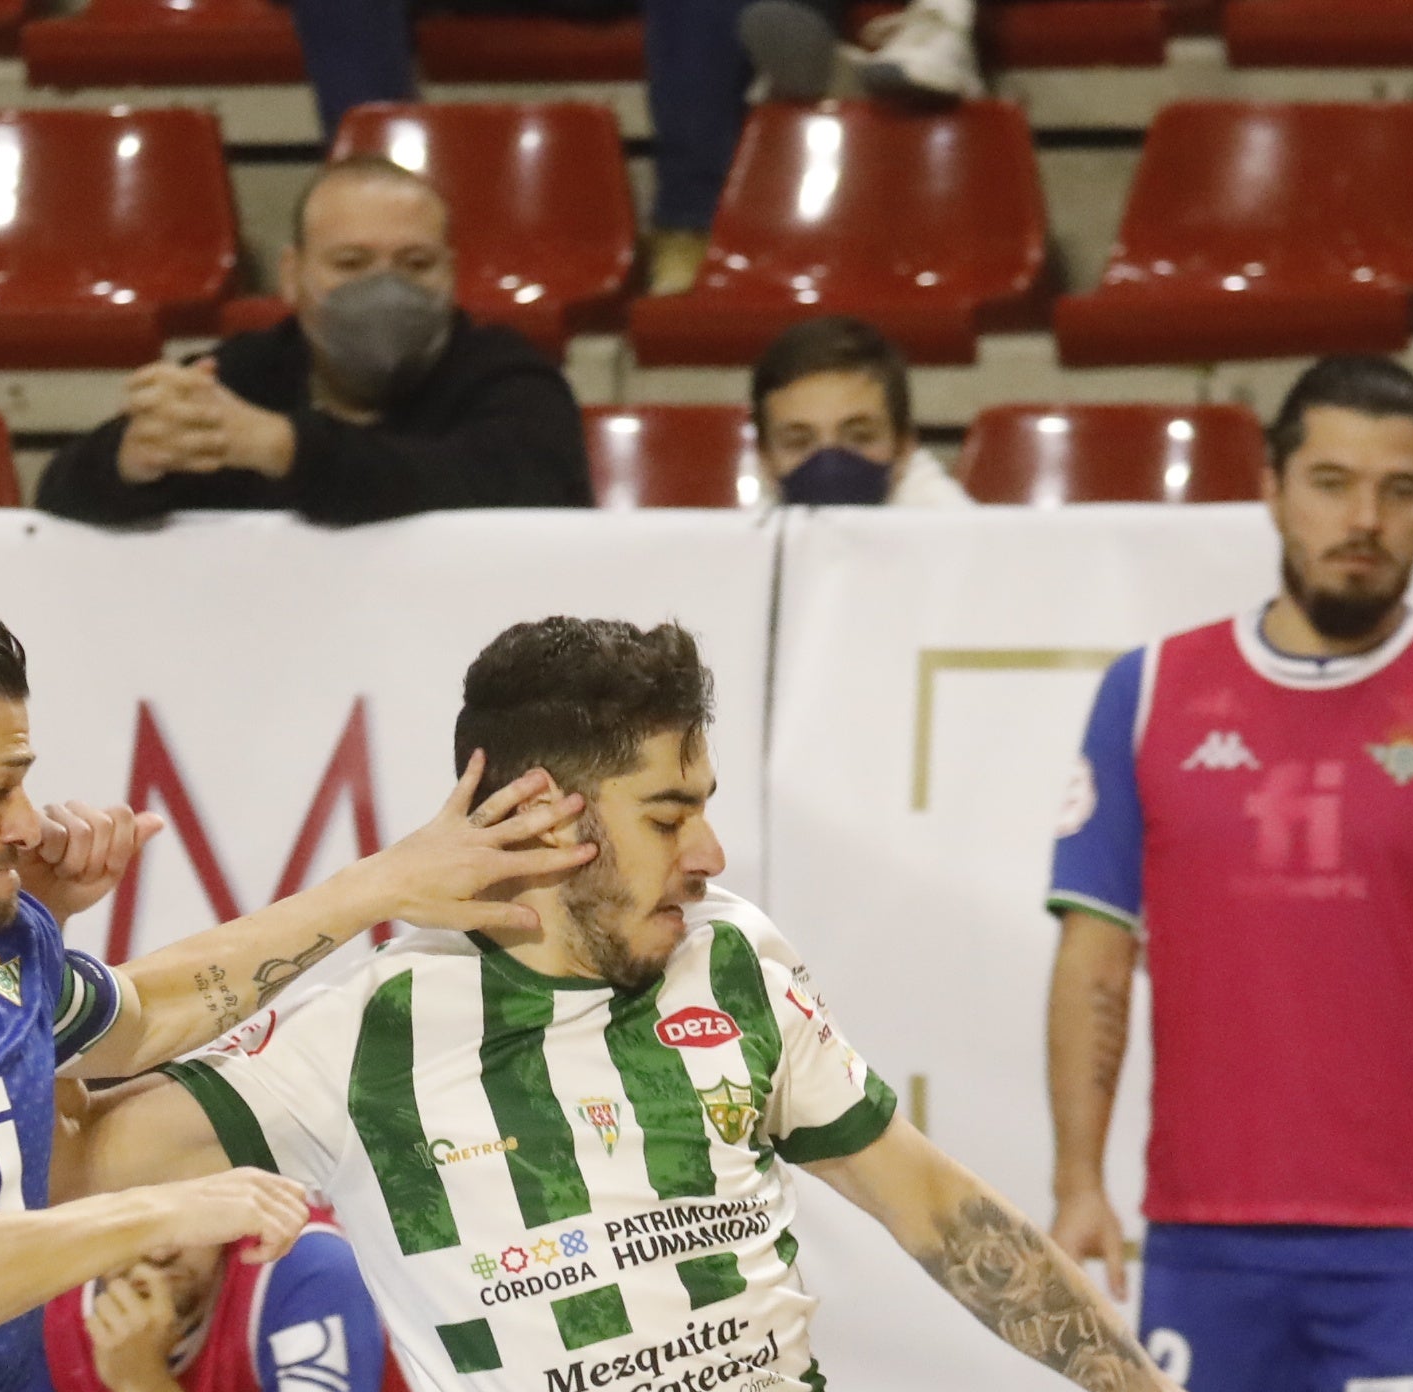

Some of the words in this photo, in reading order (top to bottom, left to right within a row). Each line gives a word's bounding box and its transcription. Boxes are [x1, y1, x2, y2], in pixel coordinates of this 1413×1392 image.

[445, 1136, 520, 1165] METROS
[612, 1211, 770, 1270] HUMANIDAD
[480, 1262, 597, 1306] CÓRDOBA
